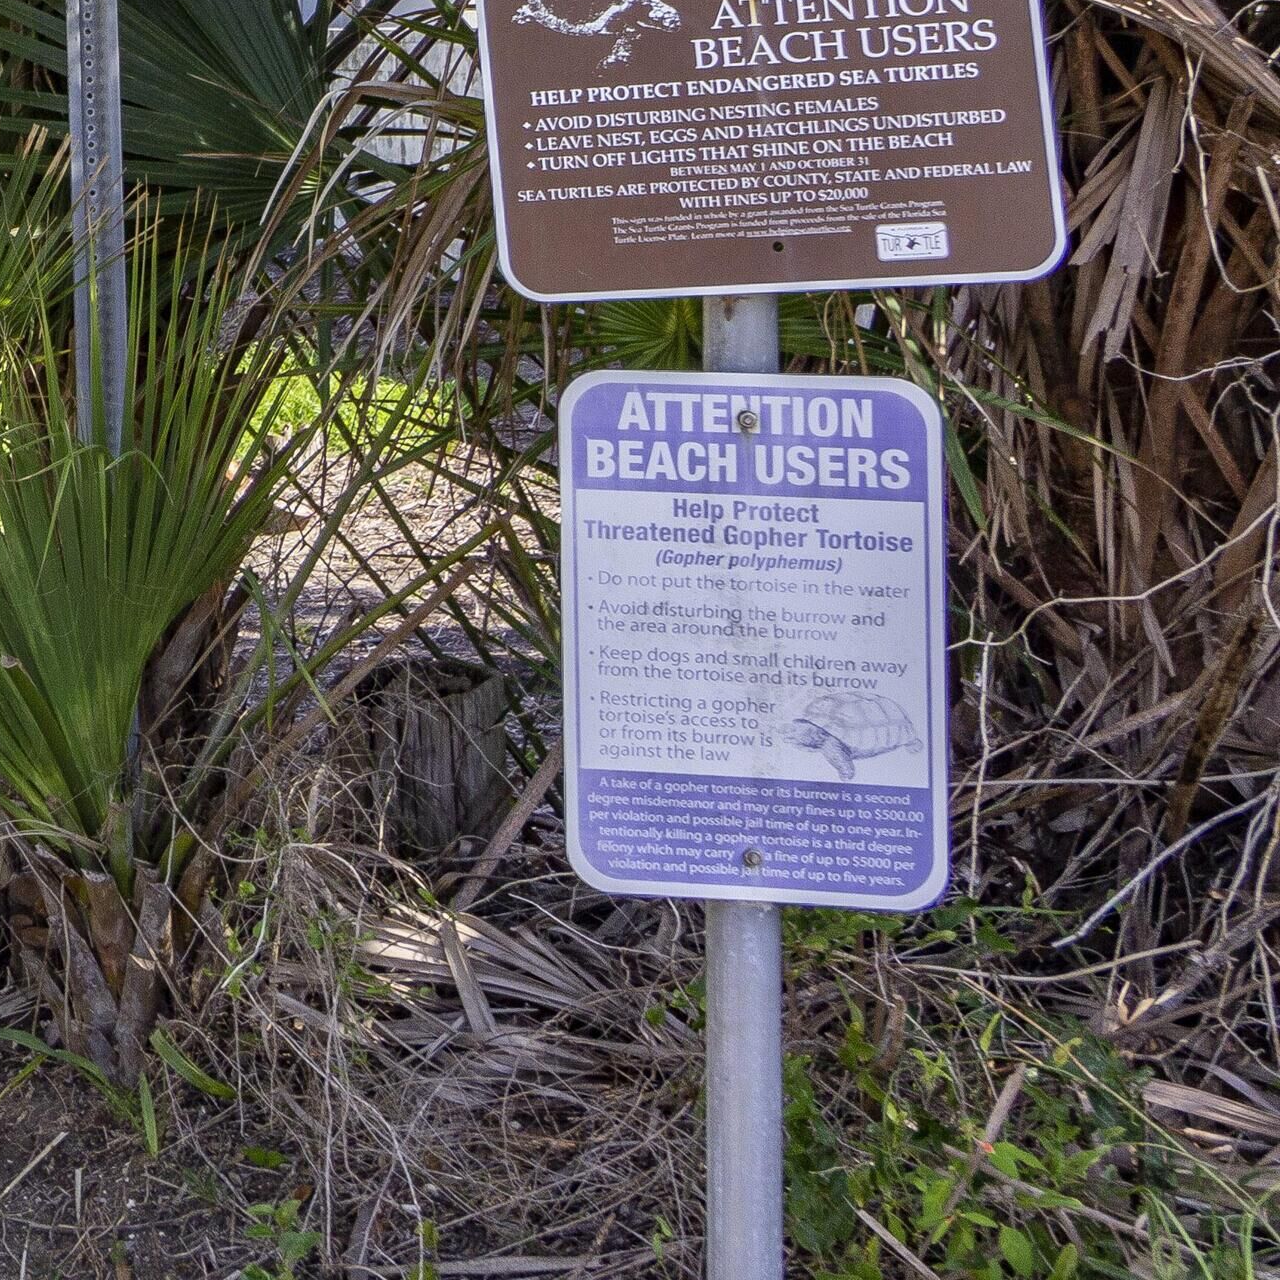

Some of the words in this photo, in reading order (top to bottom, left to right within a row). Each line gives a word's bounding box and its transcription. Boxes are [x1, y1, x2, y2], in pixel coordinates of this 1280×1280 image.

[692, 28, 848, 69] BEACH
[858, 18, 998, 58] USERS
[530, 88, 582, 106] HELP
[586, 82, 682, 102] PROTECT
[686, 72, 835, 96] ENDANGERED
[838, 69, 880, 86] SEA
[883, 62, 979, 82] TURTLES
[534, 115, 592, 132] AVOID
[595, 108, 706, 128] DISTURBING
[709, 102, 790, 120] NESTING
[793, 96, 879, 115] FEMALES
[536, 135, 593, 151] LEAVE
[596, 131, 645, 147] NEST,
[648, 128, 697, 144] EGGS
[701, 125, 743, 141] AND
[746, 117, 870, 138] HATCHLINGS
[872, 109, 1006, 130] UNDISTURBED
[537, 155, 588, 170] TURN
[591, 152, 626, 167] OFF
[630, 148, 696, 165] LIGHTS
[698, 144, 749, 161] THAT
[751, 141, 810, 158] SHINE
[812, 139, 842, 154] ON
[845, 136, 885, 152] THE
[887, 132, 953, 149] BEACH
[669, 165, 728, 177] BETWEEN
[729, 162, 756, 174] MAY
[768, 160, 796, 171] AND
[796, 157, 855, 169] OCTOBER
[857, 156, 869, 166] 31
[517, 190, 546, 202] SEA
[546, 185, 614, 200] TURTLES
[616, 183, 647, 196] ARE
[649, 178, 738, 194] PROTECTED
[740, 177, 760, 189] BY
[762, 172, 832, 187] COUNTY,
[834, 169, 881, 183] STATE
[884, 167, 921, 180] AND
[922, 162, 995, 178] FEDERAL
[995, 160, 1032, 174] LAW
[678, 195, 721, 208] WITH
[723, 192, 768, 206] FINES
[769, 191, 792, 204] UP
[792, 190, 816, 202] TO
[817, 187, 868, 201] $20,000
[616, 391, 874, 438] ATTENTION
[584, 437, 738, 482] BEACH
[752, 444, 912, 490] USERS
[671, 497, 725, 522] Help
[731, 499, 820, 523] Protect
[582, 519, 716, 544] Threatened
[721, 524, 808, 550] Gopher
[814, 528, 914, 552] Tortoise
[655, 550, 725, 568] (Gopher
[727, 553, 842, 574] polyphemus)
[598, 570, 622, 586] Do
[627, 575, 656, 587] not
[661, 576, 691, 591] put
[696, 575, 727, 591] the
[729, 577, 798, 594] tortoise
[802, 580, 819, 594] in
[823, 580, 854, 596] the
[857, 584, 911, 599] water
[598, 600, 648, 617] Avoid
[652, 602, 742, 621] disturbing
[747, 606, 776, 623] the
[781, 608, 846, 624] burrow
[850, 611, 886, 627] and
[597, 617, 625, 631] the
[629, 621, 667, 633] area
[670, 621, 736, 637] around
[738, 623, 768, 638] the
[772, 624, 837, 640] burrow
[597, 663, 638, 677] from
[643, 665, 672, 679] the
[676, 667, 746, 682] tortoise
[748, 670, 783, 685] and
[786, 671, 807, 686] its
[811, 672, 878, 689] burrow
[599, 646, 642, 666] Keep
[646, 648, 690, 669] dogs
[694, 651, 728, 665] and
[731, 653, 779, 670] small
[782, 654, 856, 671] children
[860, 661, 908, 678] away
[599, 691, 692, 714] Restricting
[696, 699, 706, 710] a
[711, 697, 776, 718] gopher
[598, 729, 616, 738] or
[621, 726, 662, 740] from
[666, 728, 687, 743] its
[691, 729, 755, 746] burrow
[759, 733, 773, 747] is
[679, 716, 736, 728] access
[740, 717, 759, 730] to
[598, 742, 662, 759] against
[666, 744, 695, 760] the
[699, 746, 730, 761] law
[586, 792, 630, 808] degree
[630, 795, 715, 809] misdemeanor
[716, 800, 742, 811] and
[742, 803, 770, 815] may
[771, 805, 804, 817] carry
[804, 804, 835, 817] fines
[837, 809, 856, 820] up
[857, 809, 872, 820] to
[598, 825, 664, 841] tentionally
[664, 828, 702, 844] killing
[704, 833, 712, 841] a
[714, 832, 760, 849] gopher
[760, 835, 810, 848] tortoise
[811, 837, 822, 848] is
[823, 840, 833, 849] a
[833, 839, 865, 851] third
[866, 840, 913, 856] degree
